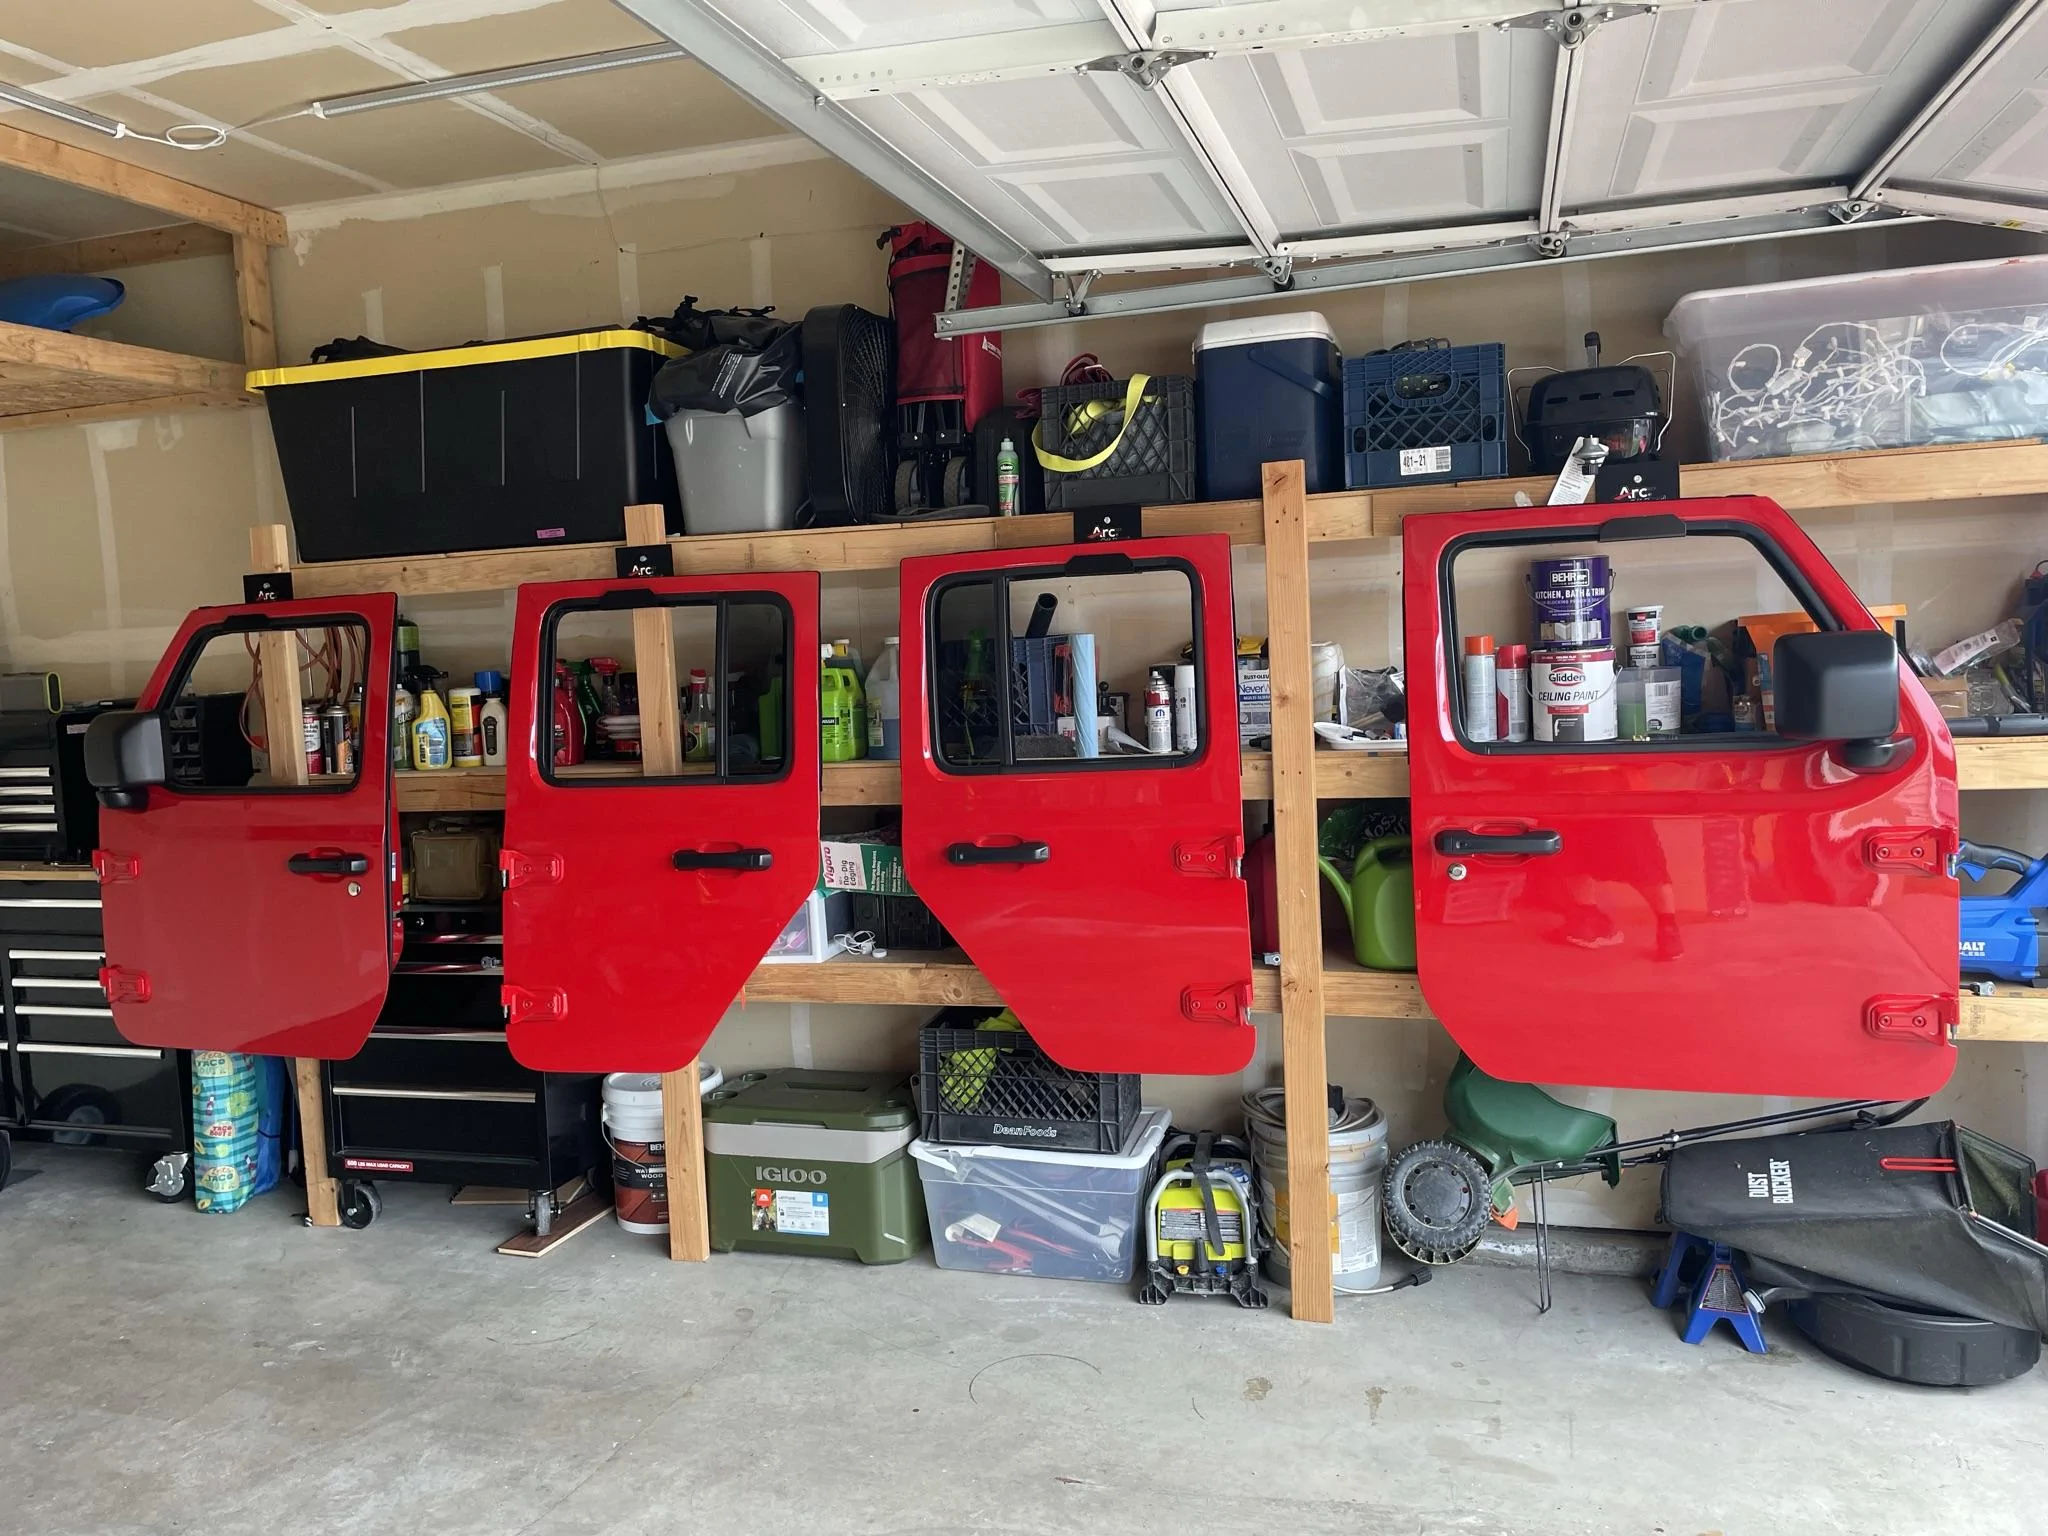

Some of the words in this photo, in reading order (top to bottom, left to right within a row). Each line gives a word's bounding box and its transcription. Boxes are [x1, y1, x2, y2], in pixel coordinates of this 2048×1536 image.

[1551, 572, 1577, 583] BEHR
[1535, 590, 1565, 600] KITCHEN,
[1565, 589, 1584, 598] BATH
[1585, 588, 1591, 597] &
[1591, 587, 1606, 596] TRIM
[1548, 673, 1586, 682] Glidden
[1240, 684, 1271, 694] NeverW
[1538, 691, 1571, 701] CEILING
[1572, 690, 1600, 701] PAINT
[823, 846, 834, 884] Vigoro
[848, 861, 857, 886] Edging
[1959, 941, 1986, 951] ALT
[992, 1123, 1058, 1138] DeanFoods
[649, 1143, 665, 1151] BEH
[208, 1173, 234, 1182] TACO
[755, 1166, 827, 1185] IGLOO
[1770, 1159, 1794, 1204] BLOCKER
[1748, 1172, 1769, 1198] DUST
